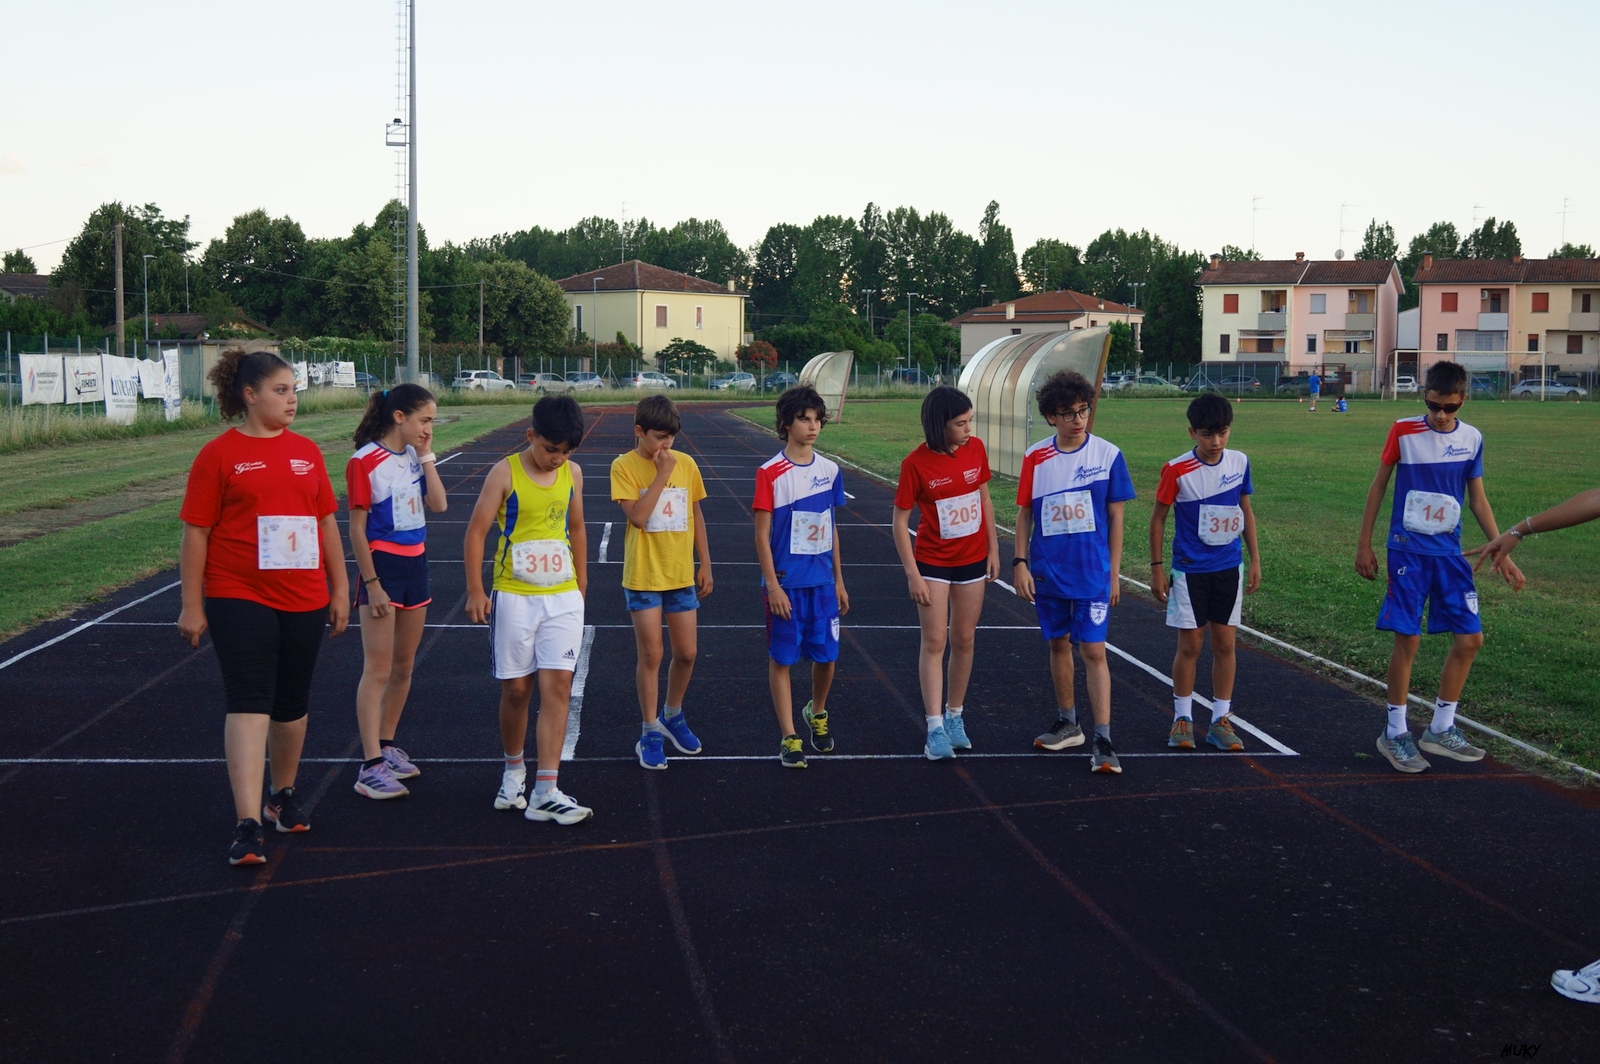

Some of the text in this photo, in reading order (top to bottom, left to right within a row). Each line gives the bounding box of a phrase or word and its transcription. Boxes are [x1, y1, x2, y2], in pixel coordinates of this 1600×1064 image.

[407, 497, 420, 515] 1
[662, 500, 673, 518] 4
[949, 504, 978, 526] 205
[1051, 503, 1085, 522] 206
[1423, 505, 1445, 523] 14
[807, 524, 825, 541] 21
[1209, 517, 1240, 533] 318
[287, 531, 296, 552] 1
[525, 554, 563, 573] 319
